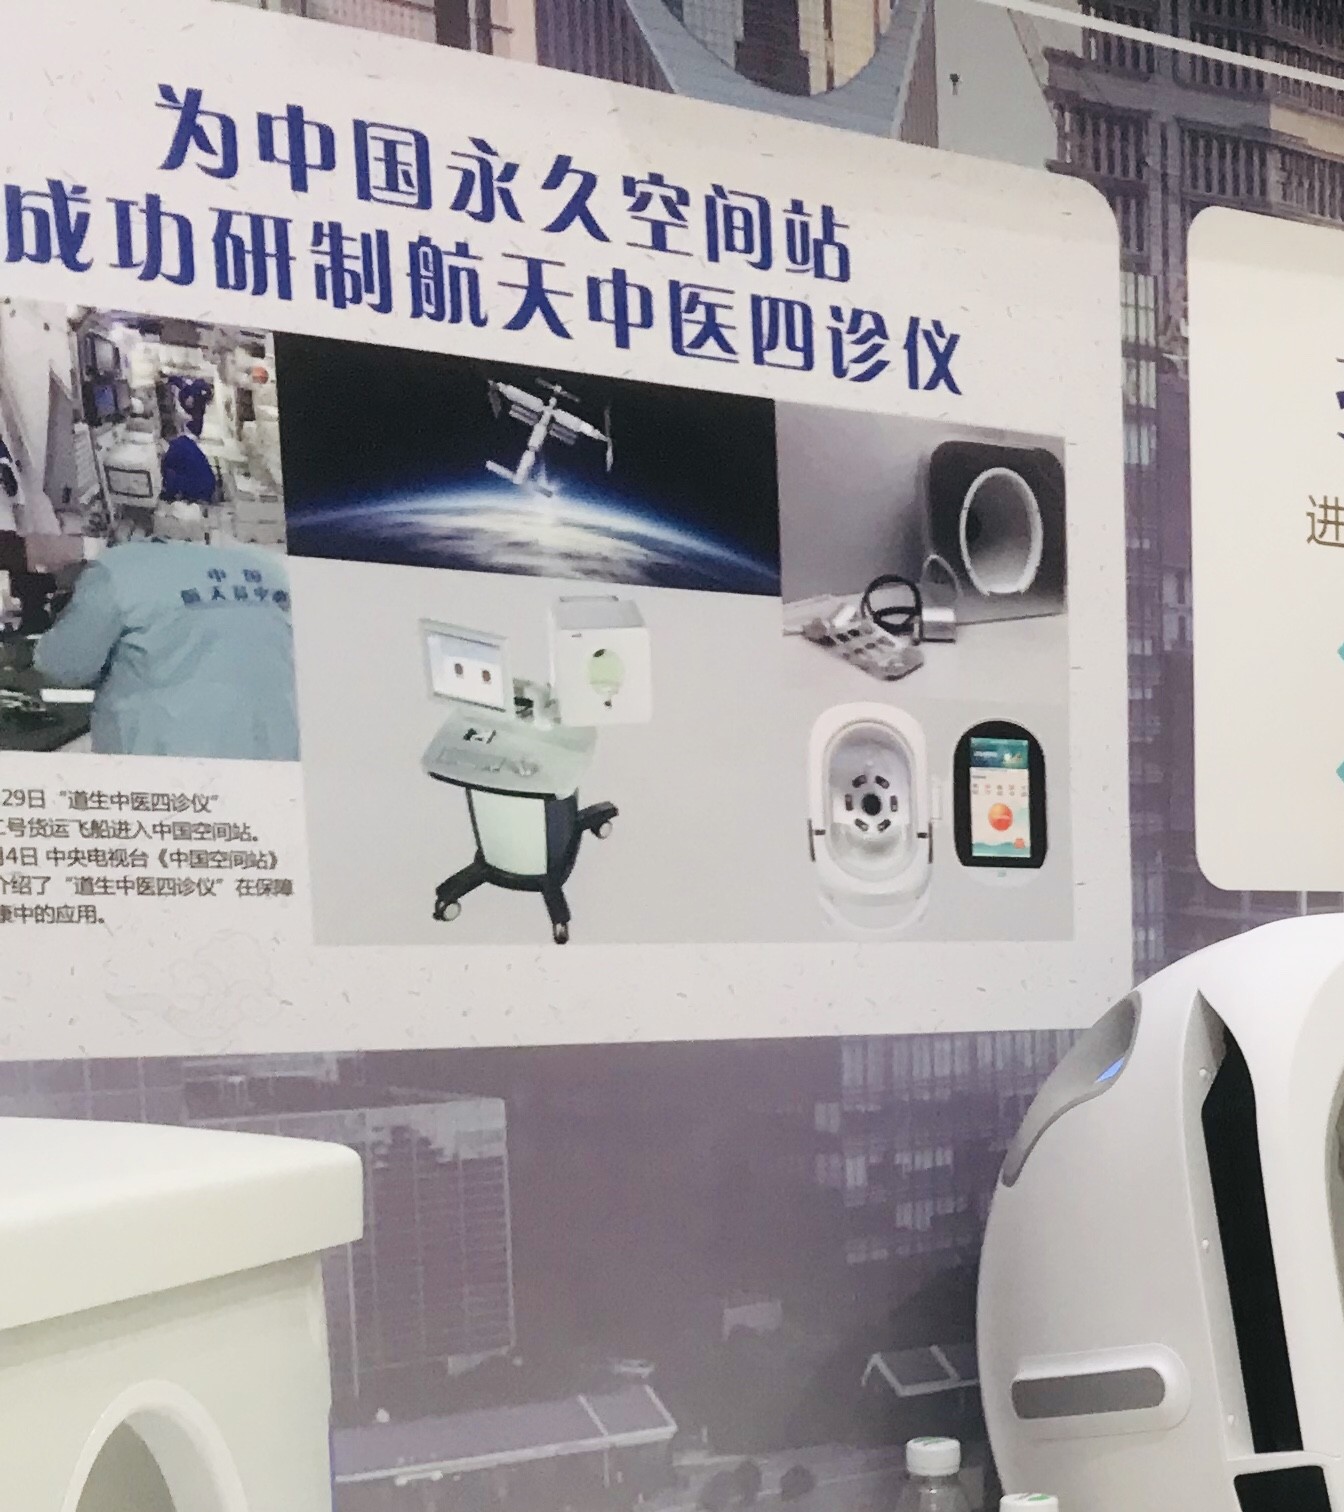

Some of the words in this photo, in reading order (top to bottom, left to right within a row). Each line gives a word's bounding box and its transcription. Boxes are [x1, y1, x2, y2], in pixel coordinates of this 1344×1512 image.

[155, 83, 852, 285] 为中国永久空间站
[2, 181, 964, 396] 成功研制航天中医四诊仪
[0, 817, 258, 842] 号货运飞船进入中国空间站。
